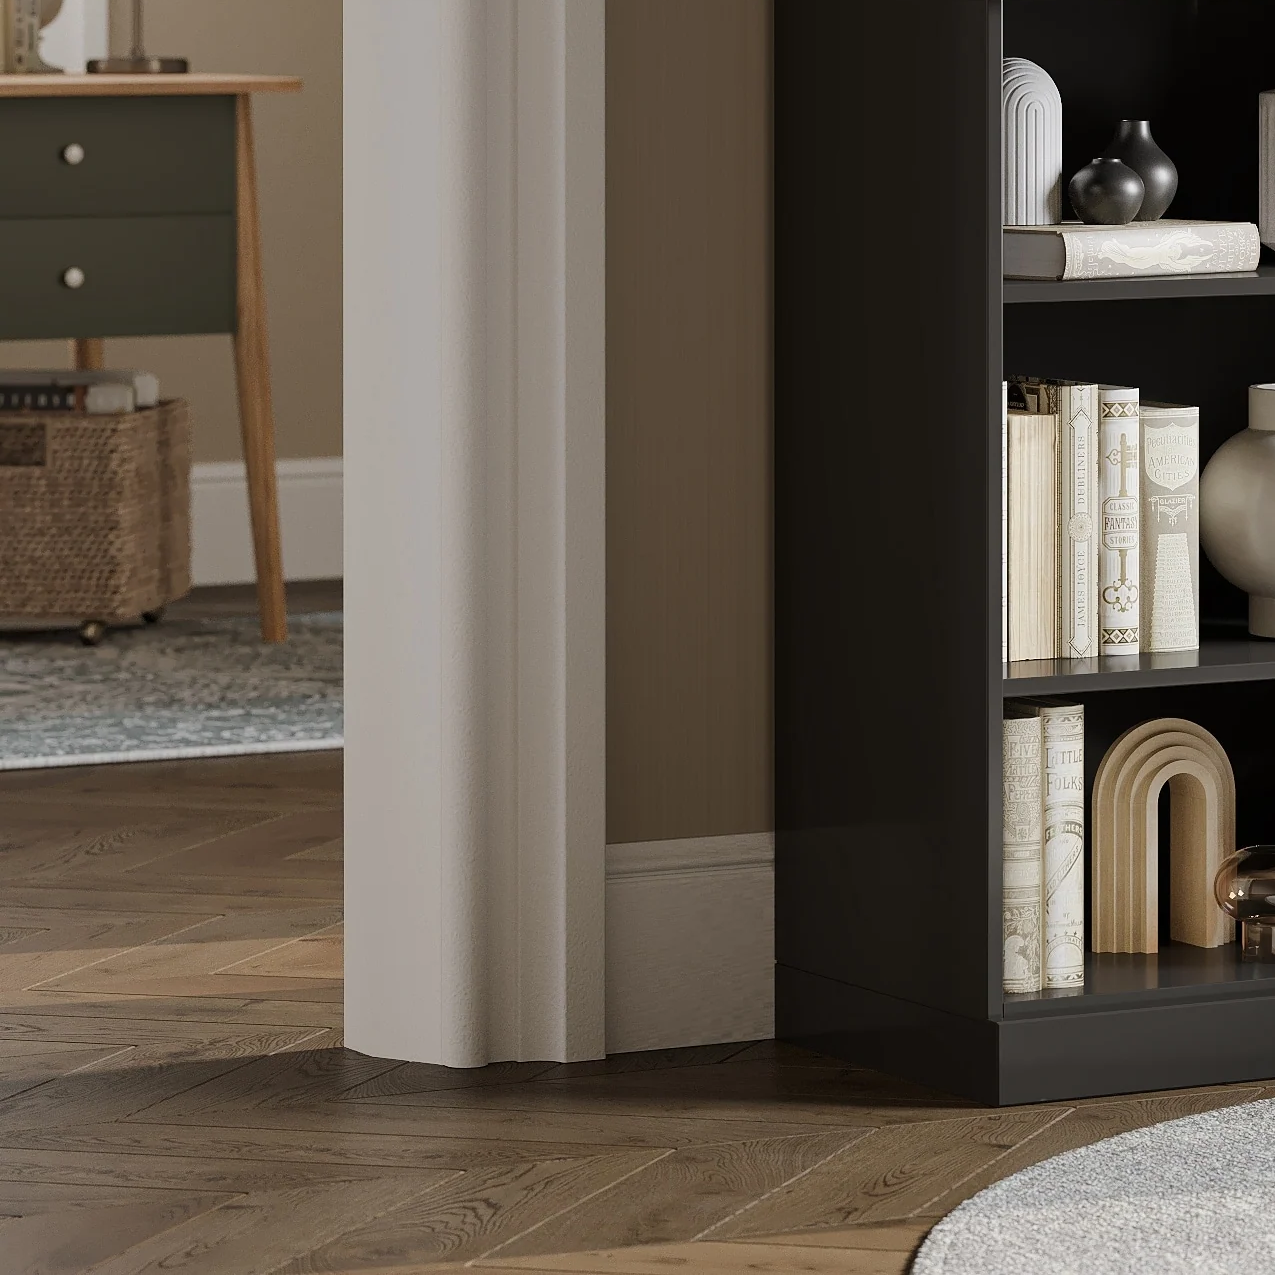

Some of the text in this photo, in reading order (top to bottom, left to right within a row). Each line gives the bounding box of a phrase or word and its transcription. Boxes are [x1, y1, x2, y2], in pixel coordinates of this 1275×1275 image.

[1077, 435, 1086, 506] DUBLINERS
[1148, 455, 1195, 470] AMERICAN
[1154, 468, 1190, 481] CITIES
[1109, 501, 1136, 513] CLASSIC
[1159, 498, 1187, 506] GLAZIER
[1109, 534, 1136, 546] STORIES
[1076, 550, 1086, 628] JAMES JOYCE
[1008, 737, 1038, 758] FIVE
[1045, 746, 1083, 771] LITTLE
[1045, 772, 1083, 798] FOLKS
